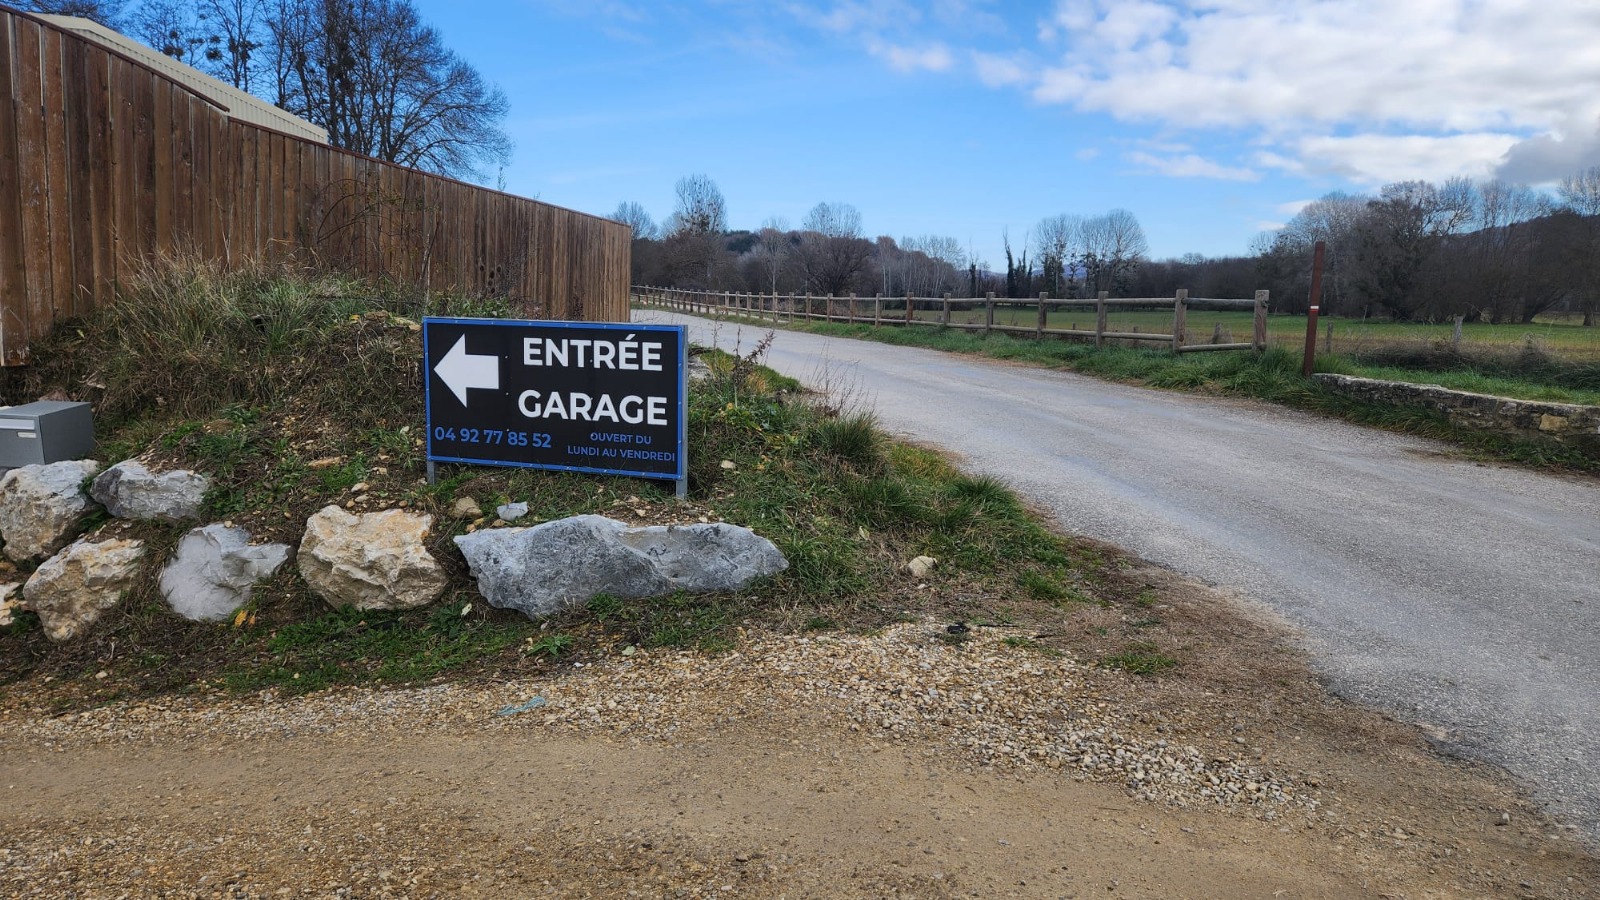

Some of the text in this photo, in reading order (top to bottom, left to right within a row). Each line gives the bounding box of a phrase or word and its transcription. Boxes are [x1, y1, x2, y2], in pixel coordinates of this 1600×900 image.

[523, 333, 663, 372] ENTRÉE
[518, 389, 668, 426] GARAGE
[434, 426, 552, 448] 04 92 77 85 52
[590, 432, 652, 445] OUVERT DU
[567, 445, 675, 462] LUNDI AU VENDREDI
